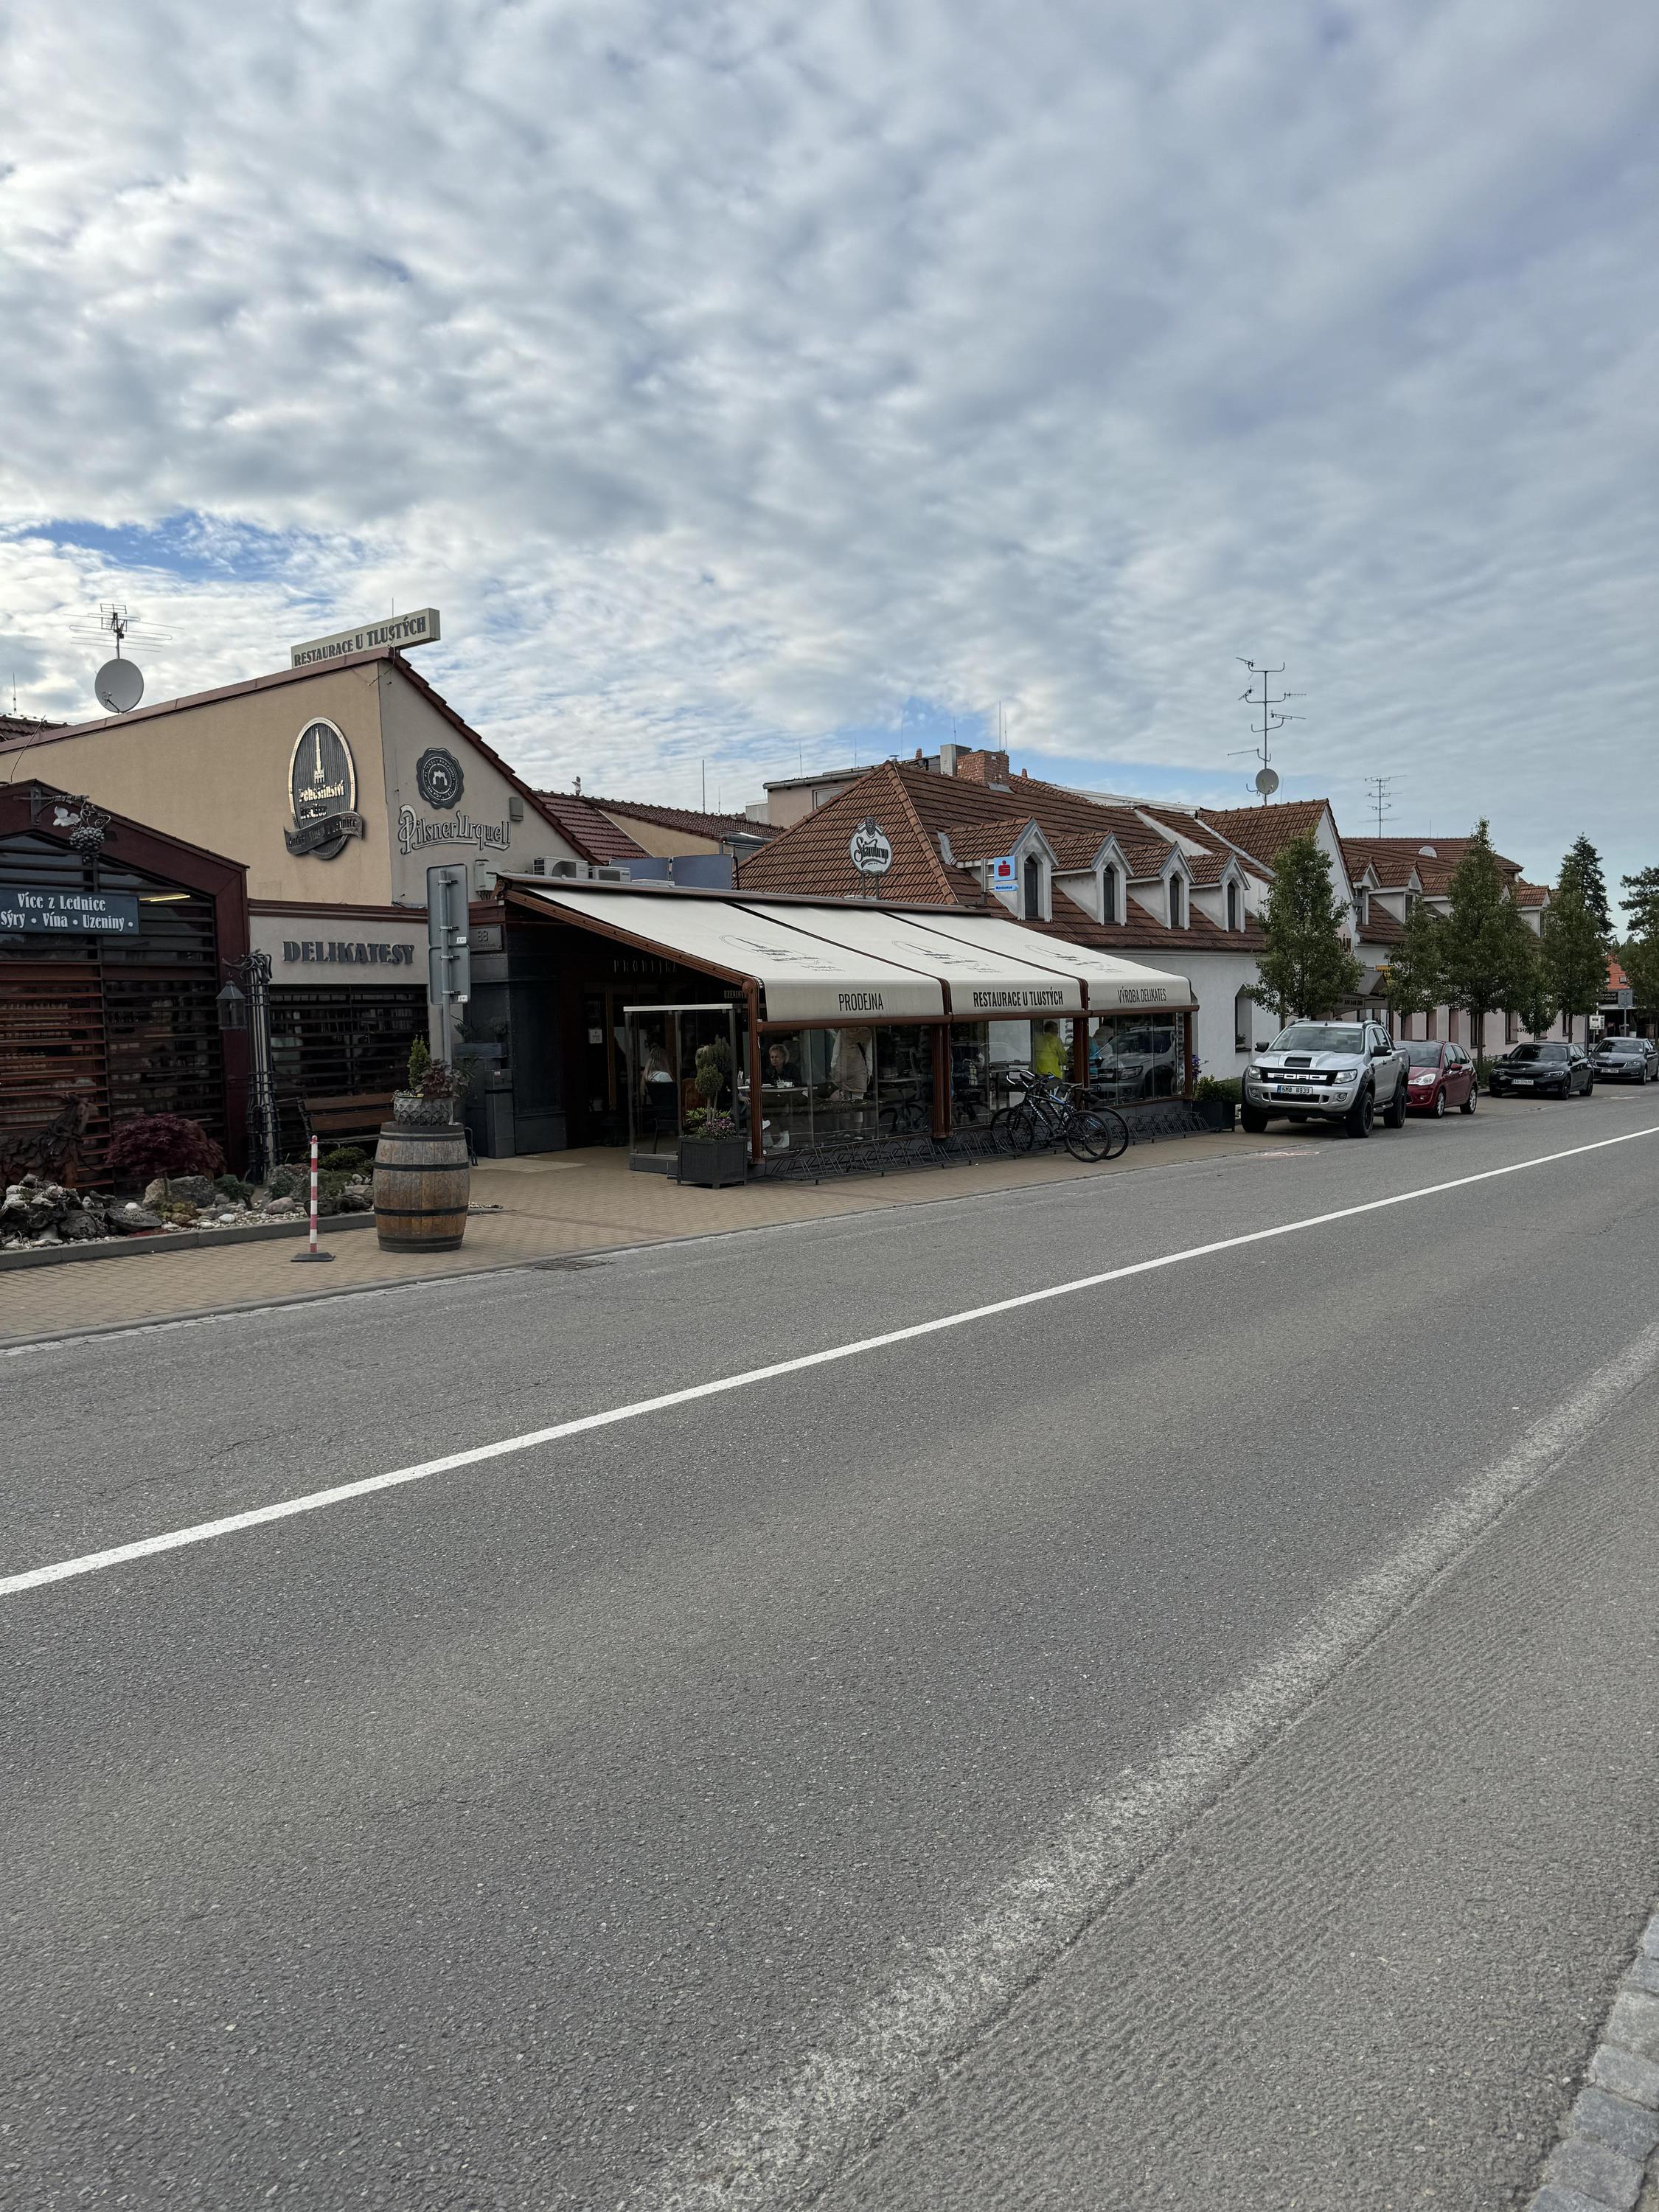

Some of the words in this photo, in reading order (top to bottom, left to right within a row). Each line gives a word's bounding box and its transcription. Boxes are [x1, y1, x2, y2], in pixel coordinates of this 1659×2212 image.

[294, 639, 354, 667] RESTAURACE
[355, 634, 364, 650] U
[366, 616, 427, 647] TLUSTÝCH
[397, 804, 457, 855] Pilsner
[456, 810, 511, 850] Urquell
[18, 892, 44, 909] Více
[48, 897, 55, 909] z
[60, 895, 106, 911] Lednice
[0, 910, 26, 928] Sýry
[42, 911, 69, 928] Vína
[83, 914, 125, 932] Uzeniny
[282, 941, 414, 965] DELIKATESY
[838, 992, 884, 1012] PRODEJNA
[973, 990, 1021, 1007] RESTAURACE
[1022, 991, 1028, 1006] U
[1029, 987, 1063, 1006] TLUSTÝCH
[1117, 985, 1140, 1004] VÝROBA
[1140, 988, 1167, 1003] DELIKATES
